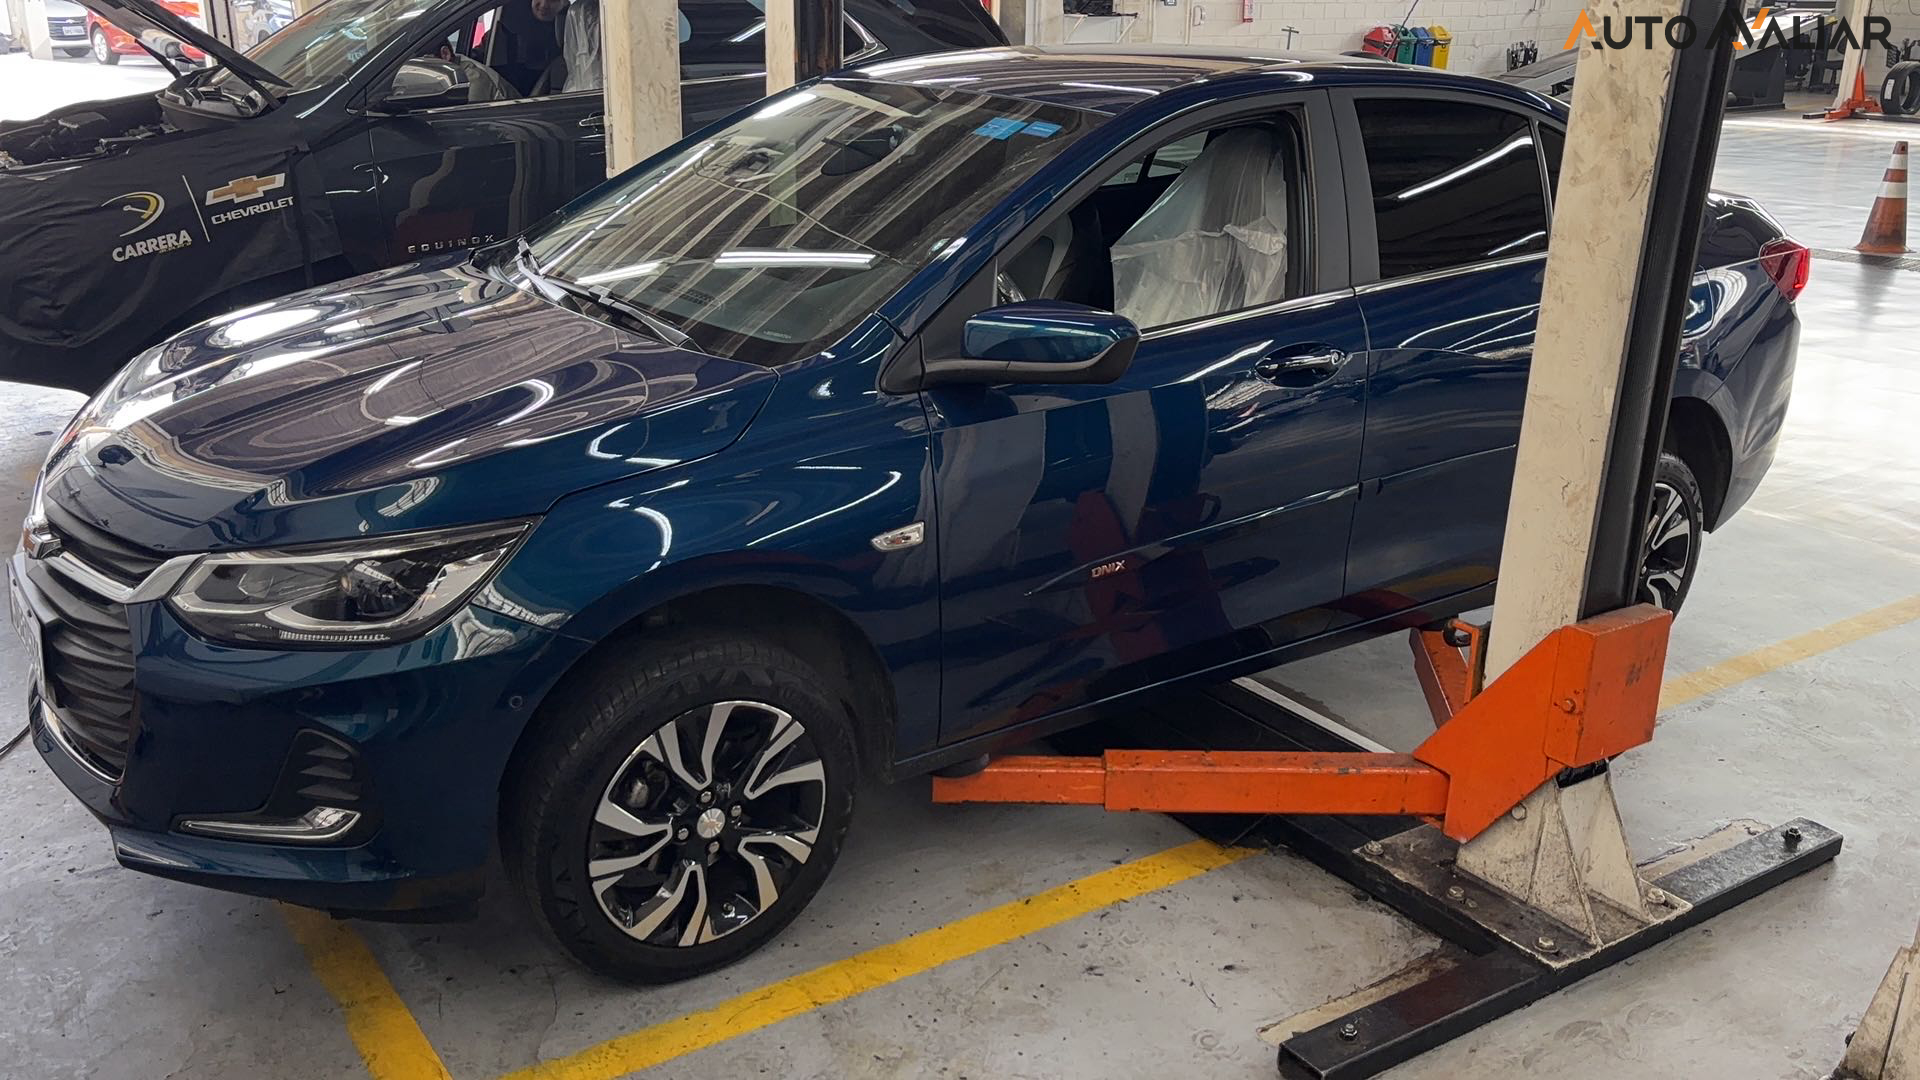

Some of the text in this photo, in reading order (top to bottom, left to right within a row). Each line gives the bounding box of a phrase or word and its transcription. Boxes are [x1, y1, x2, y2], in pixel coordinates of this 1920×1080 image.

[211, 196, 295, 225] CHEVROLET
[112, 229, 193, 262] CARRERA
[407, 234, 495, 254] EQUINOX
[1091, 560, 1126, 578] ONIX
